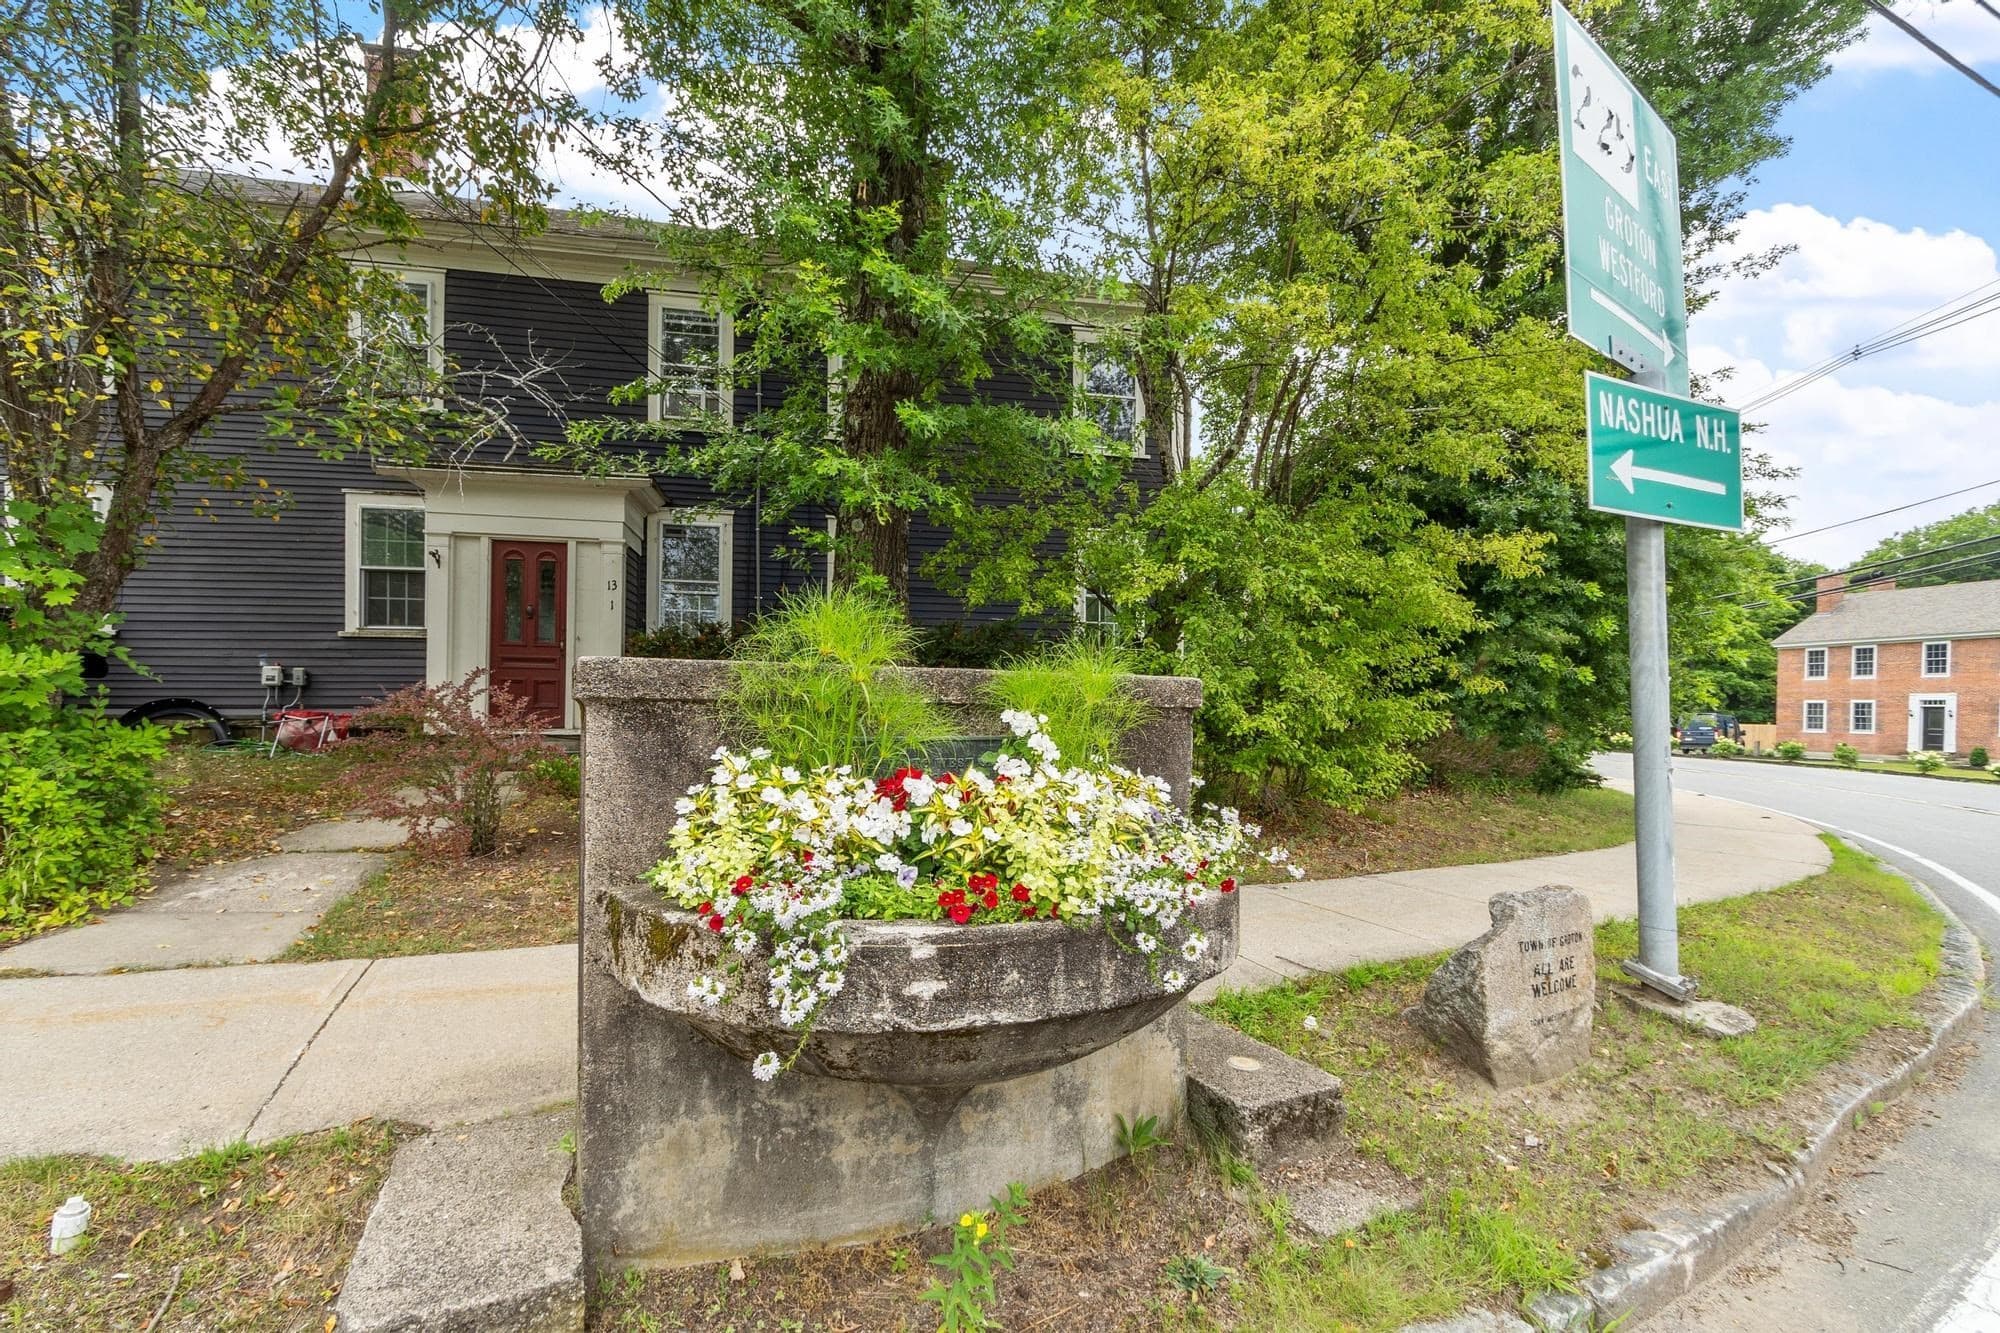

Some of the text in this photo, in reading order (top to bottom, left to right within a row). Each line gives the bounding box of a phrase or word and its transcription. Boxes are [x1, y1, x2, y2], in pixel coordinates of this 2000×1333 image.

[1644, 145, 1673, 201] EAST
[1604, 195, 1657, 269] GROTON
[1599, 235, 1666, 318] WESTFORD
[1599, 390, 1732, 454] NASHUA N.H.
[607, 579, 618, 591] 13
[1517, 940, 1544, 953] TOWN
[1547, 937, 1557, 949] OF
[1531, 974, 1577, 998] WELCOME
[1533, 955, 1575, 977] ALL ARE
